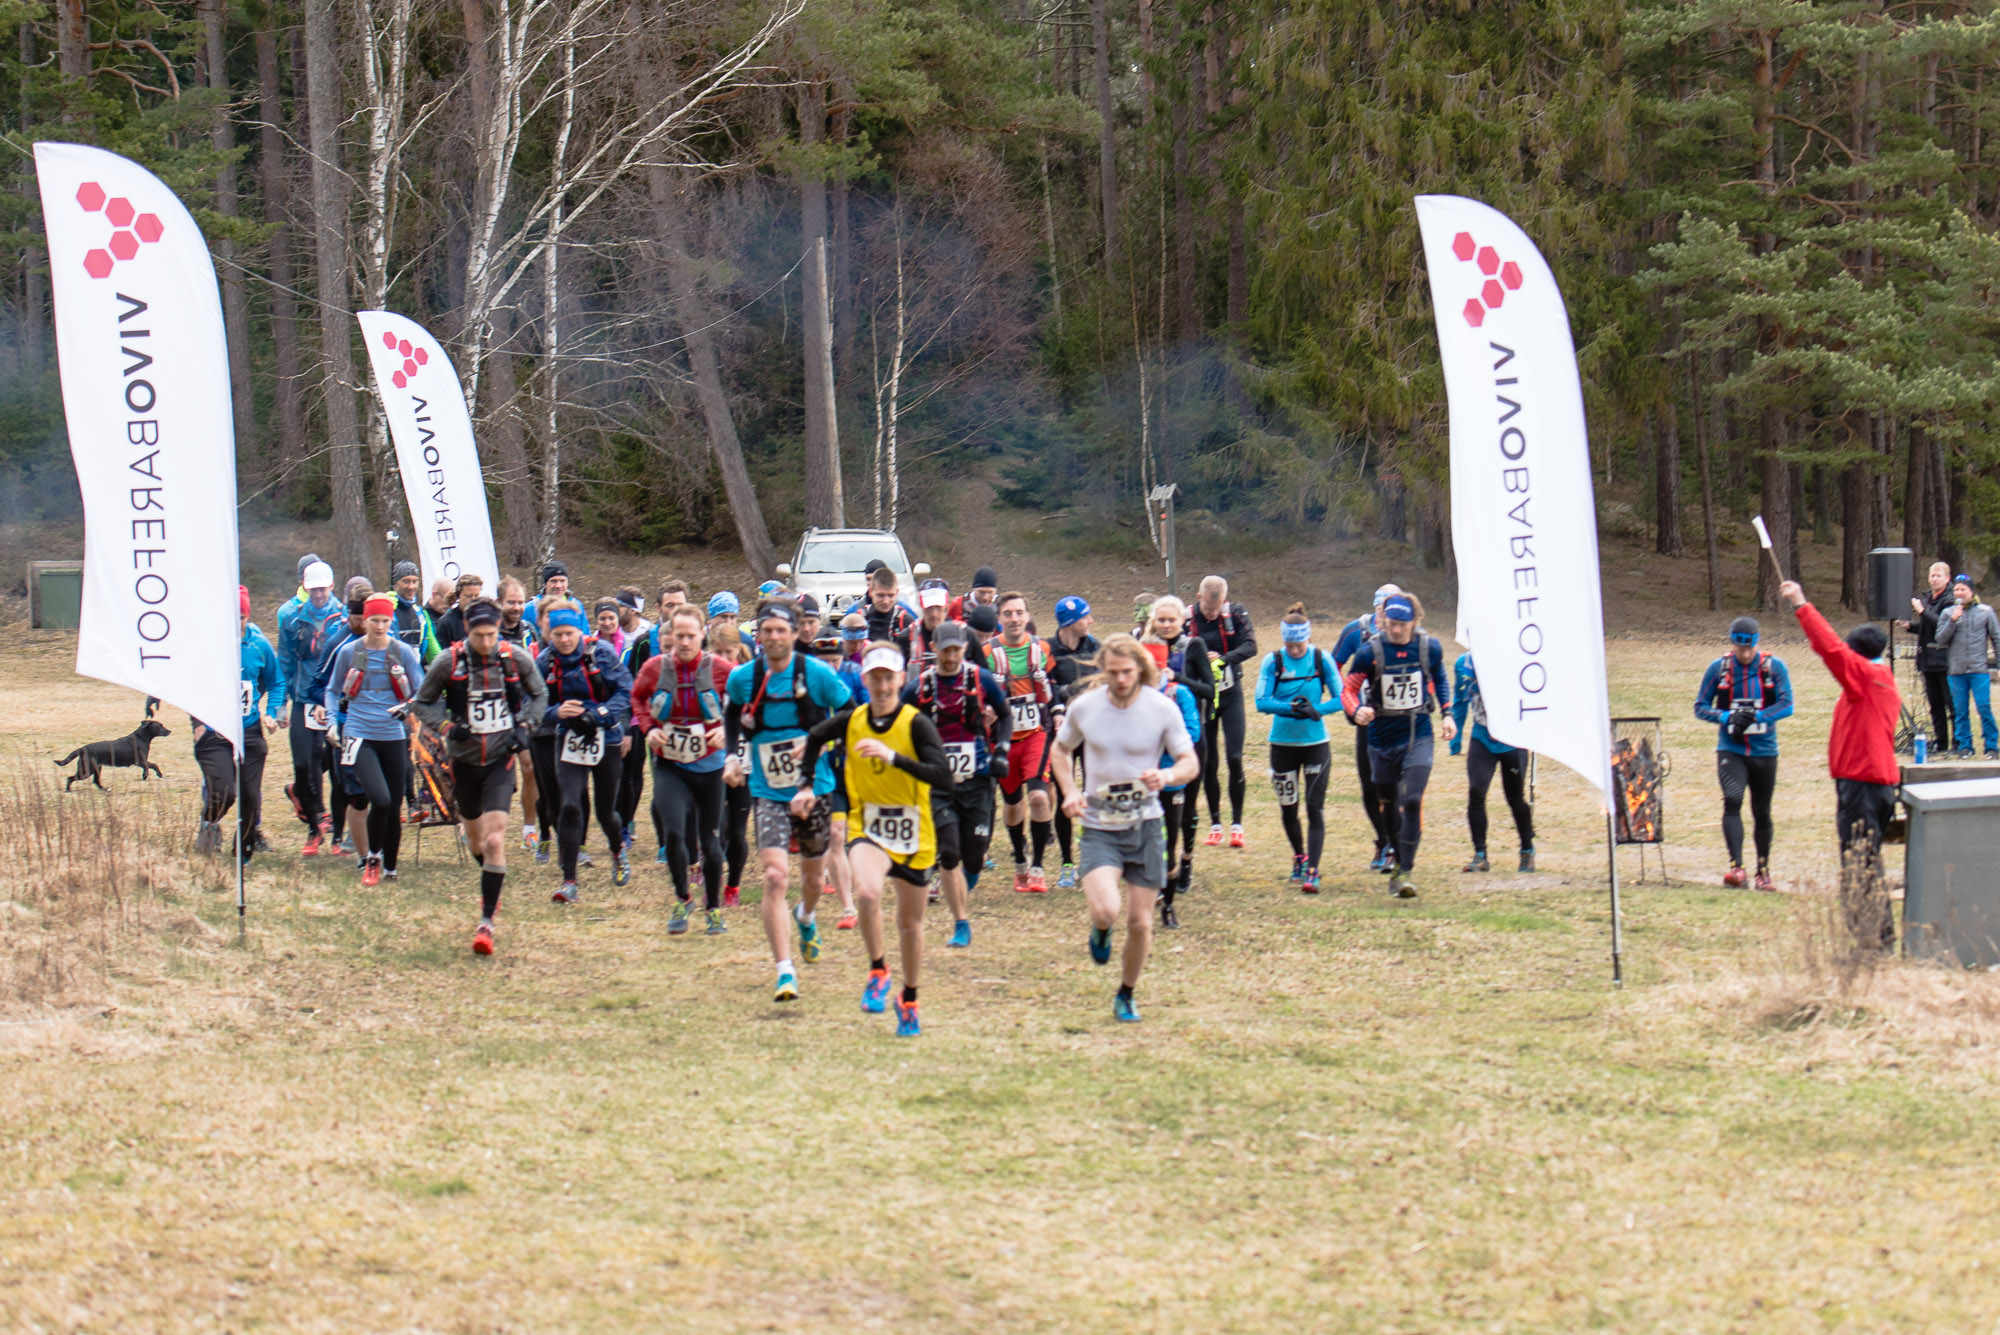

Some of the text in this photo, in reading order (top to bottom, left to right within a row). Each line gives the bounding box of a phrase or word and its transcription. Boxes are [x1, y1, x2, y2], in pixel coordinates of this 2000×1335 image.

[1386, 682, 1418, 700] 475
[473, 700, 508, 722] 512
[1014, 703, 1035, 721] 76
[567, 737, 599, 755] 546
[667, 733, 700, 753] 478
[768, 752, 795, 776] 48
[948, 754, 970, 773] 02
[870, 818, 913, 841] 498
